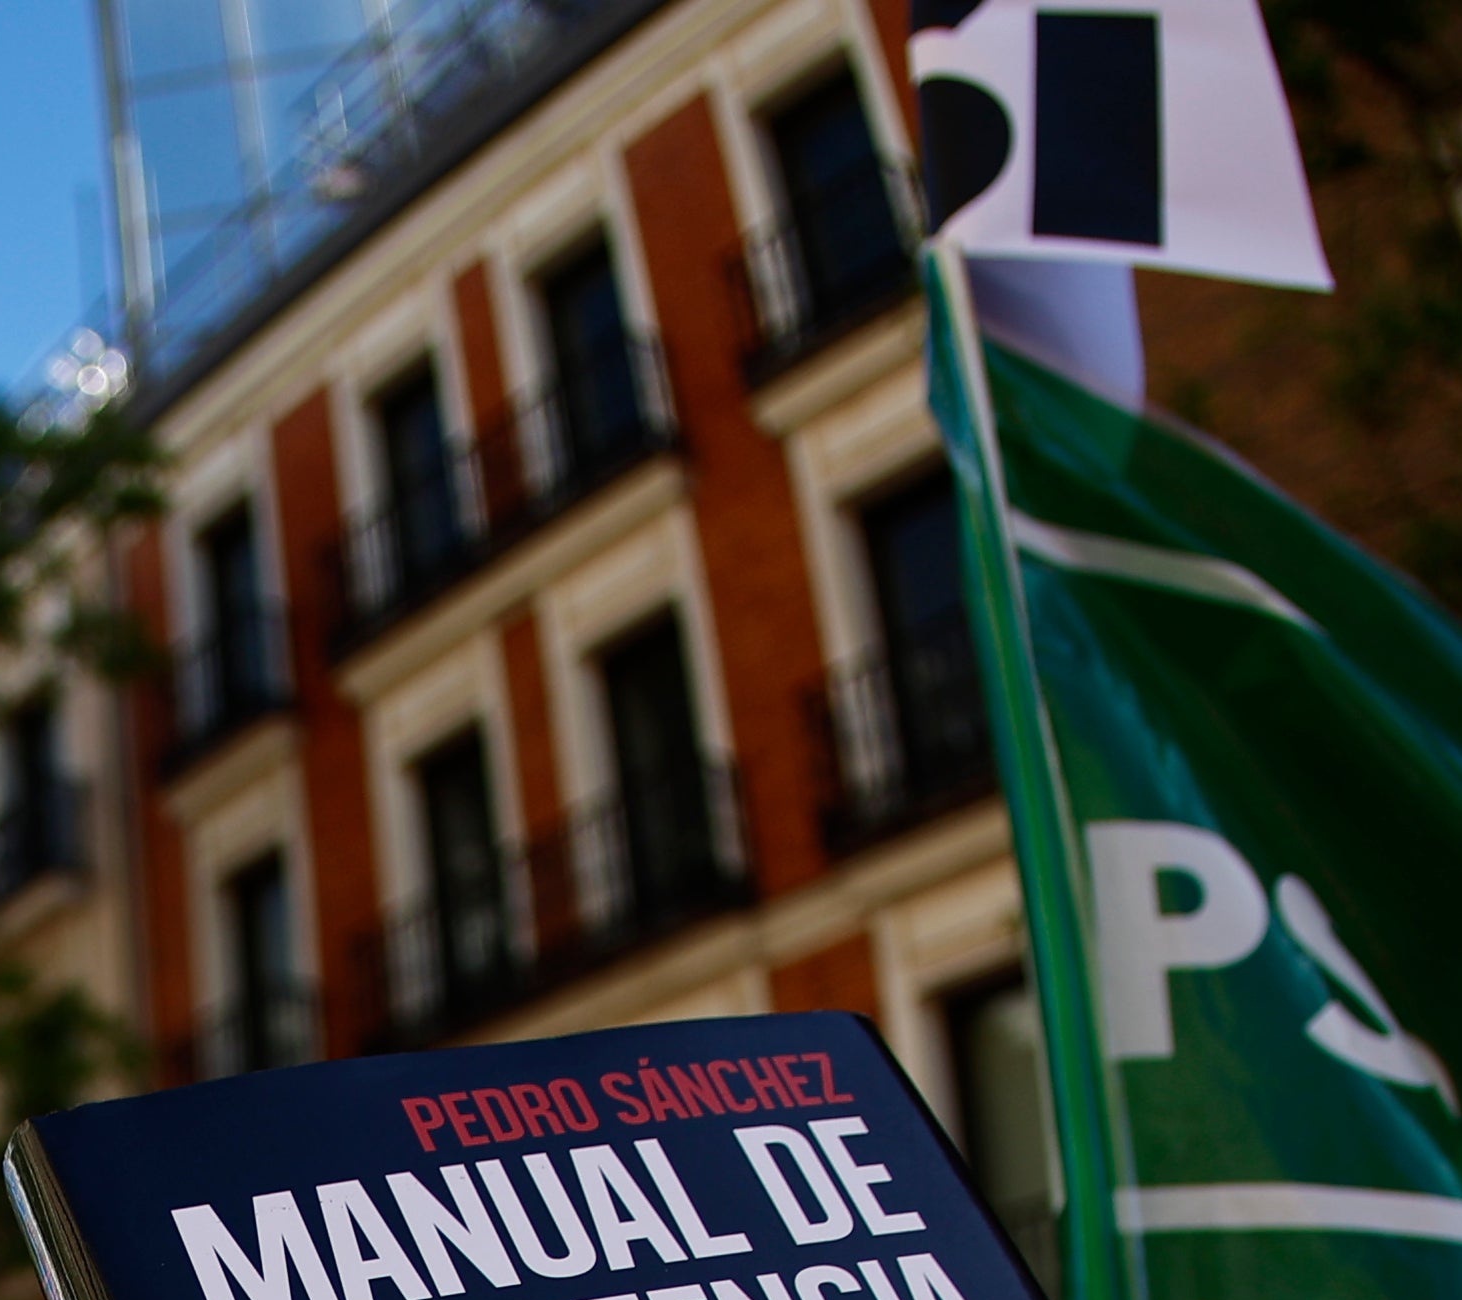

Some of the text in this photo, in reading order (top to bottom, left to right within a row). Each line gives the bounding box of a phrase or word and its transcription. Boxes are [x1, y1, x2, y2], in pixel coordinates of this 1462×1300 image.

[401, 1054, 853, 1152] PEDRO SÁNCHEZ
[733, 1116, 926, 1246] DE
